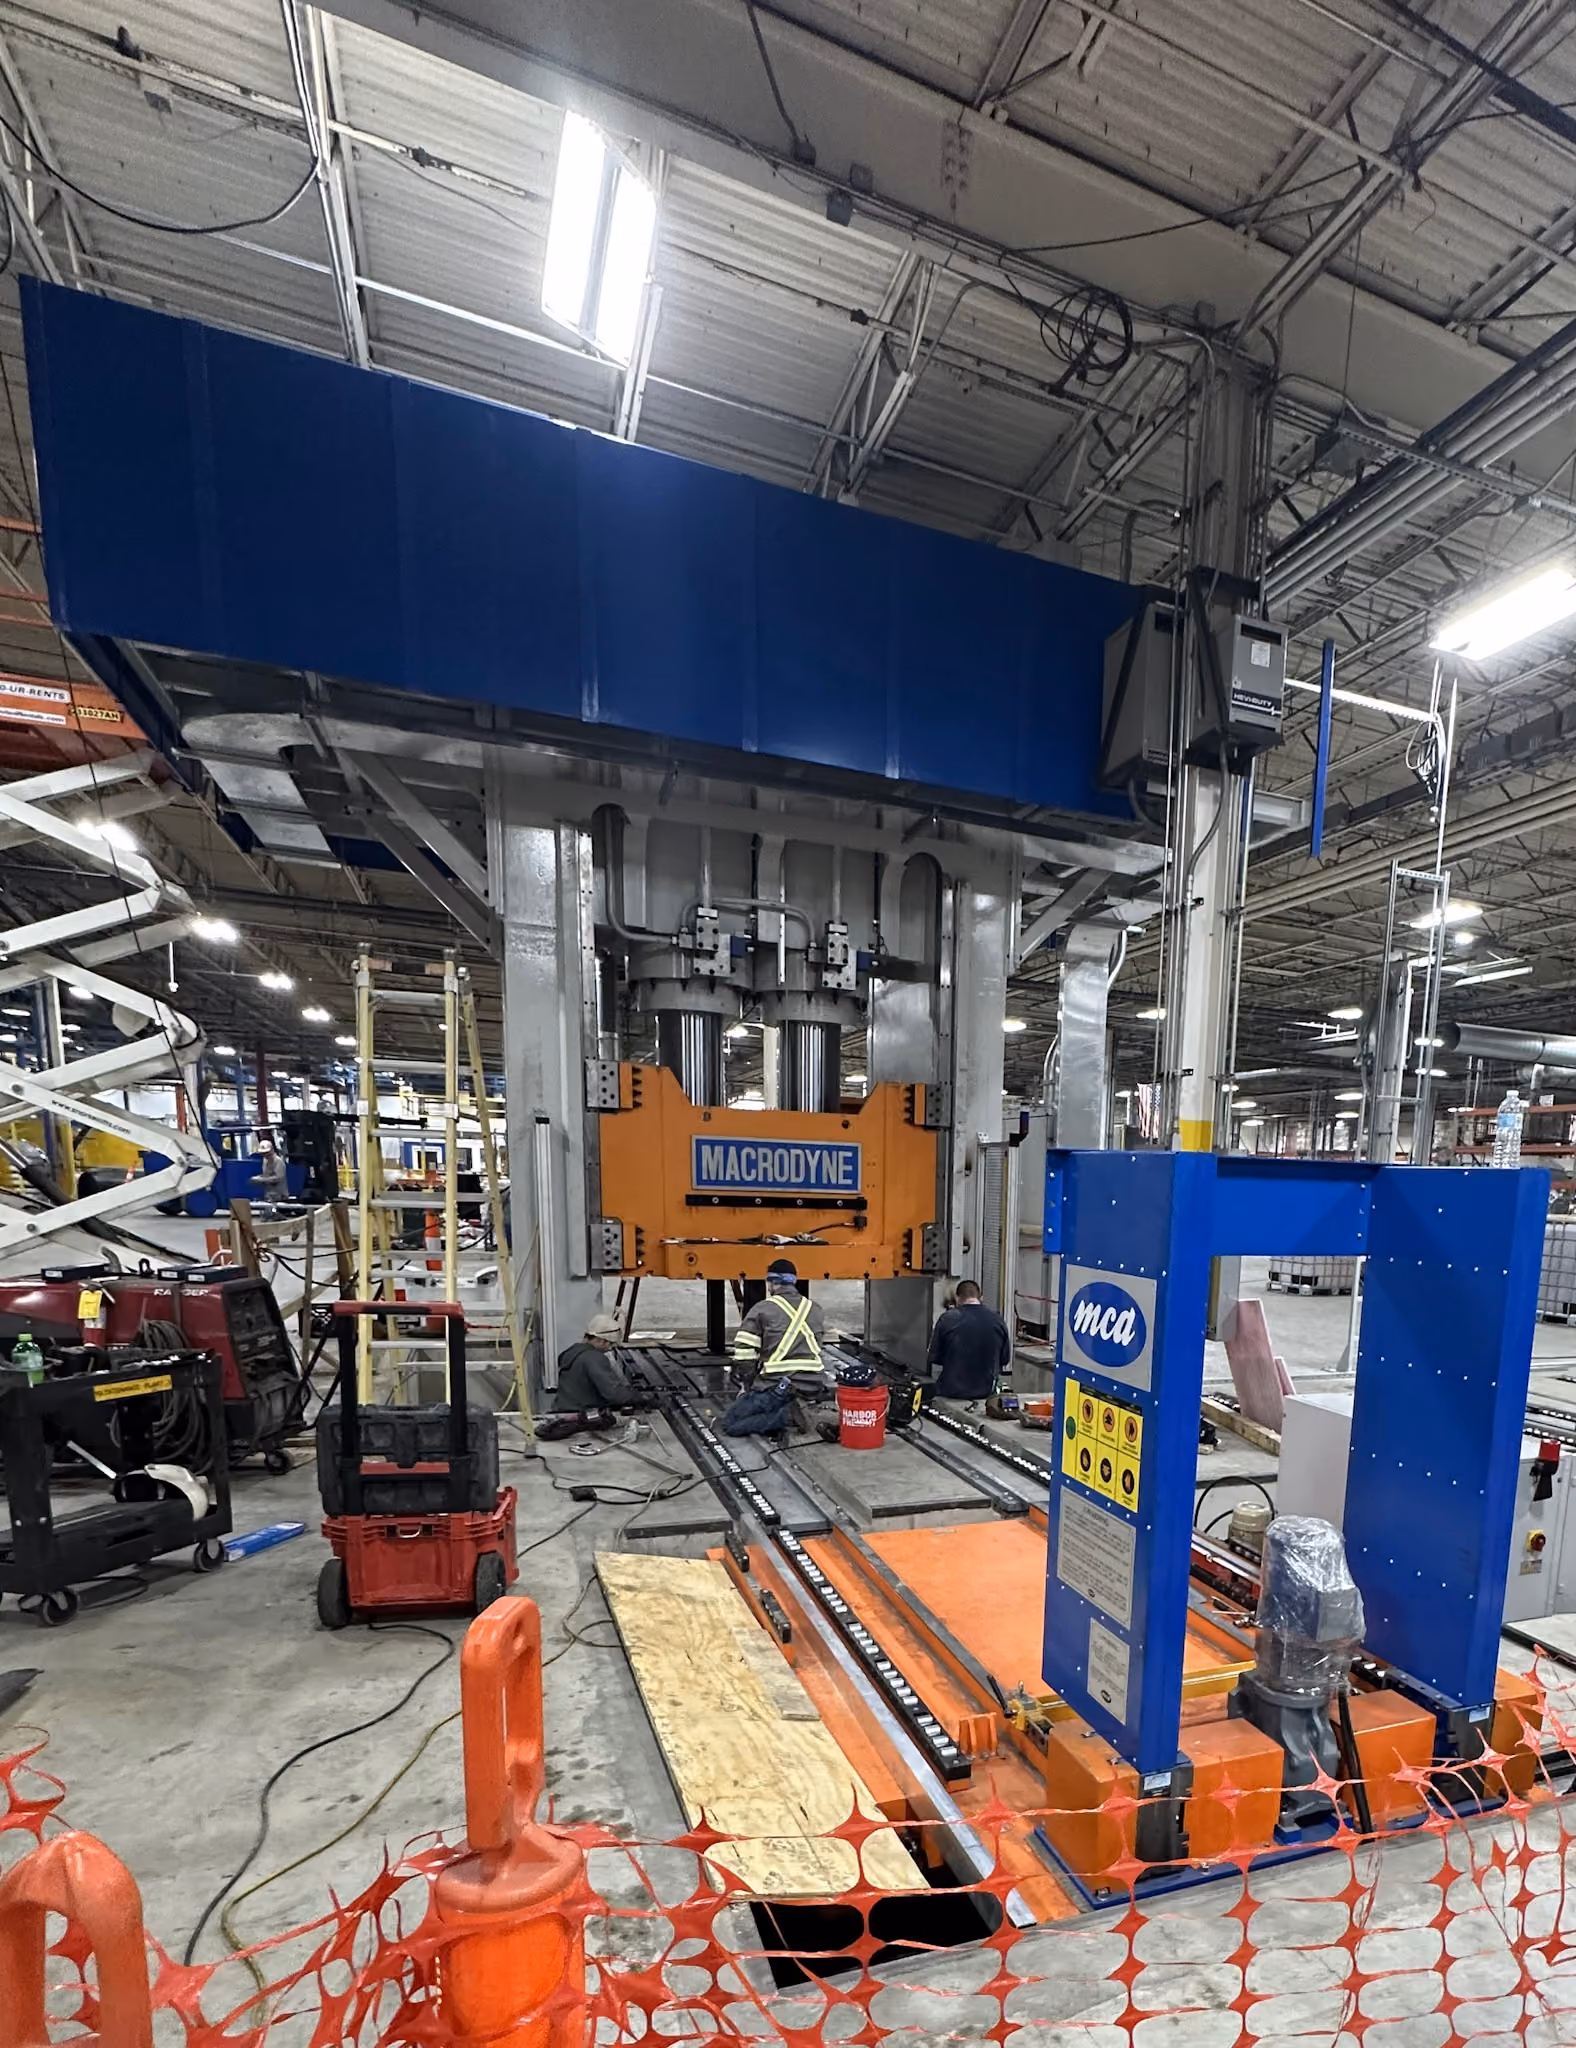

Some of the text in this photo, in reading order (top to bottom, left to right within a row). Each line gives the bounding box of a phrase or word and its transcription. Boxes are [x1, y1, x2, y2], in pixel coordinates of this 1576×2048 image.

[701, 1144, 853, 1185] MACRODYNE
[153, 1288, 209, 1297] RAGER
[1073, 1299, 1136, 1347] mca
[842, 1409, 877, 1419] HARBOR
